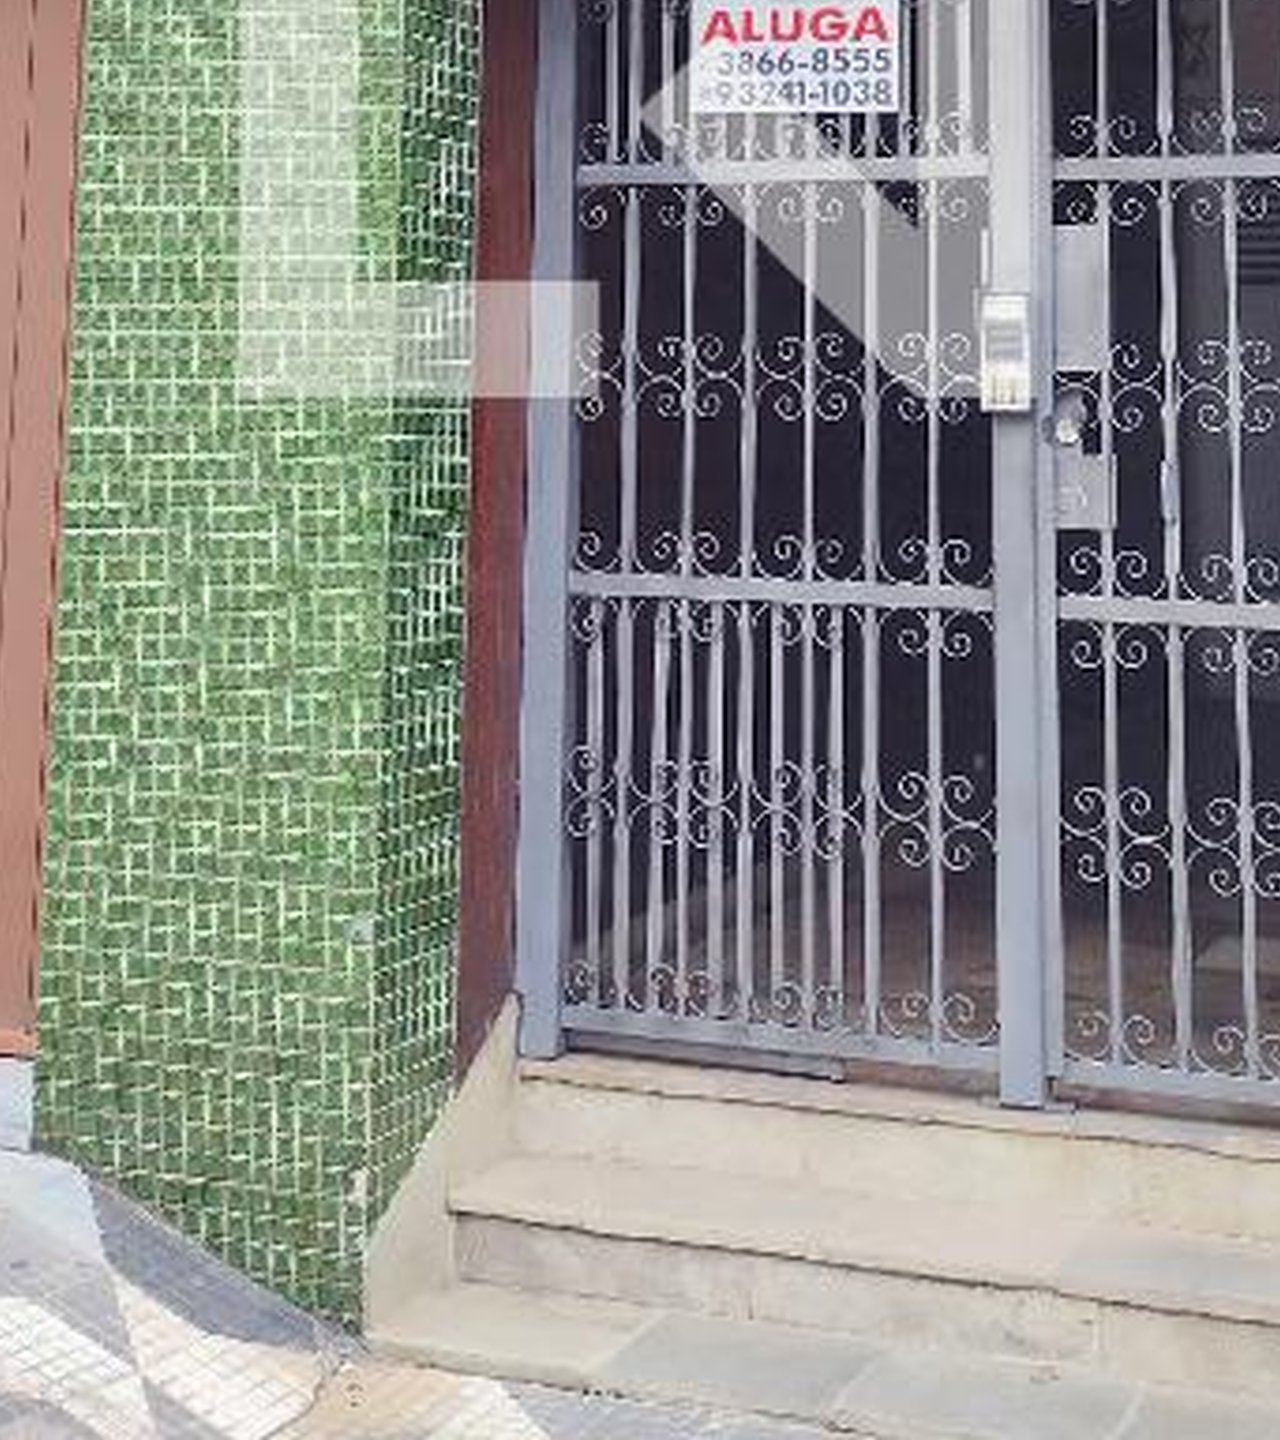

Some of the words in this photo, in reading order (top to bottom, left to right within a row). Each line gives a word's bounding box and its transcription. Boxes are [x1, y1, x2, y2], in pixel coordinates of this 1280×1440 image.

[701, 8, 888, 47] ALUGA
[719, 47, 892, 76] 3866-8555
[716, 78, 892, 106] 93241-1038
